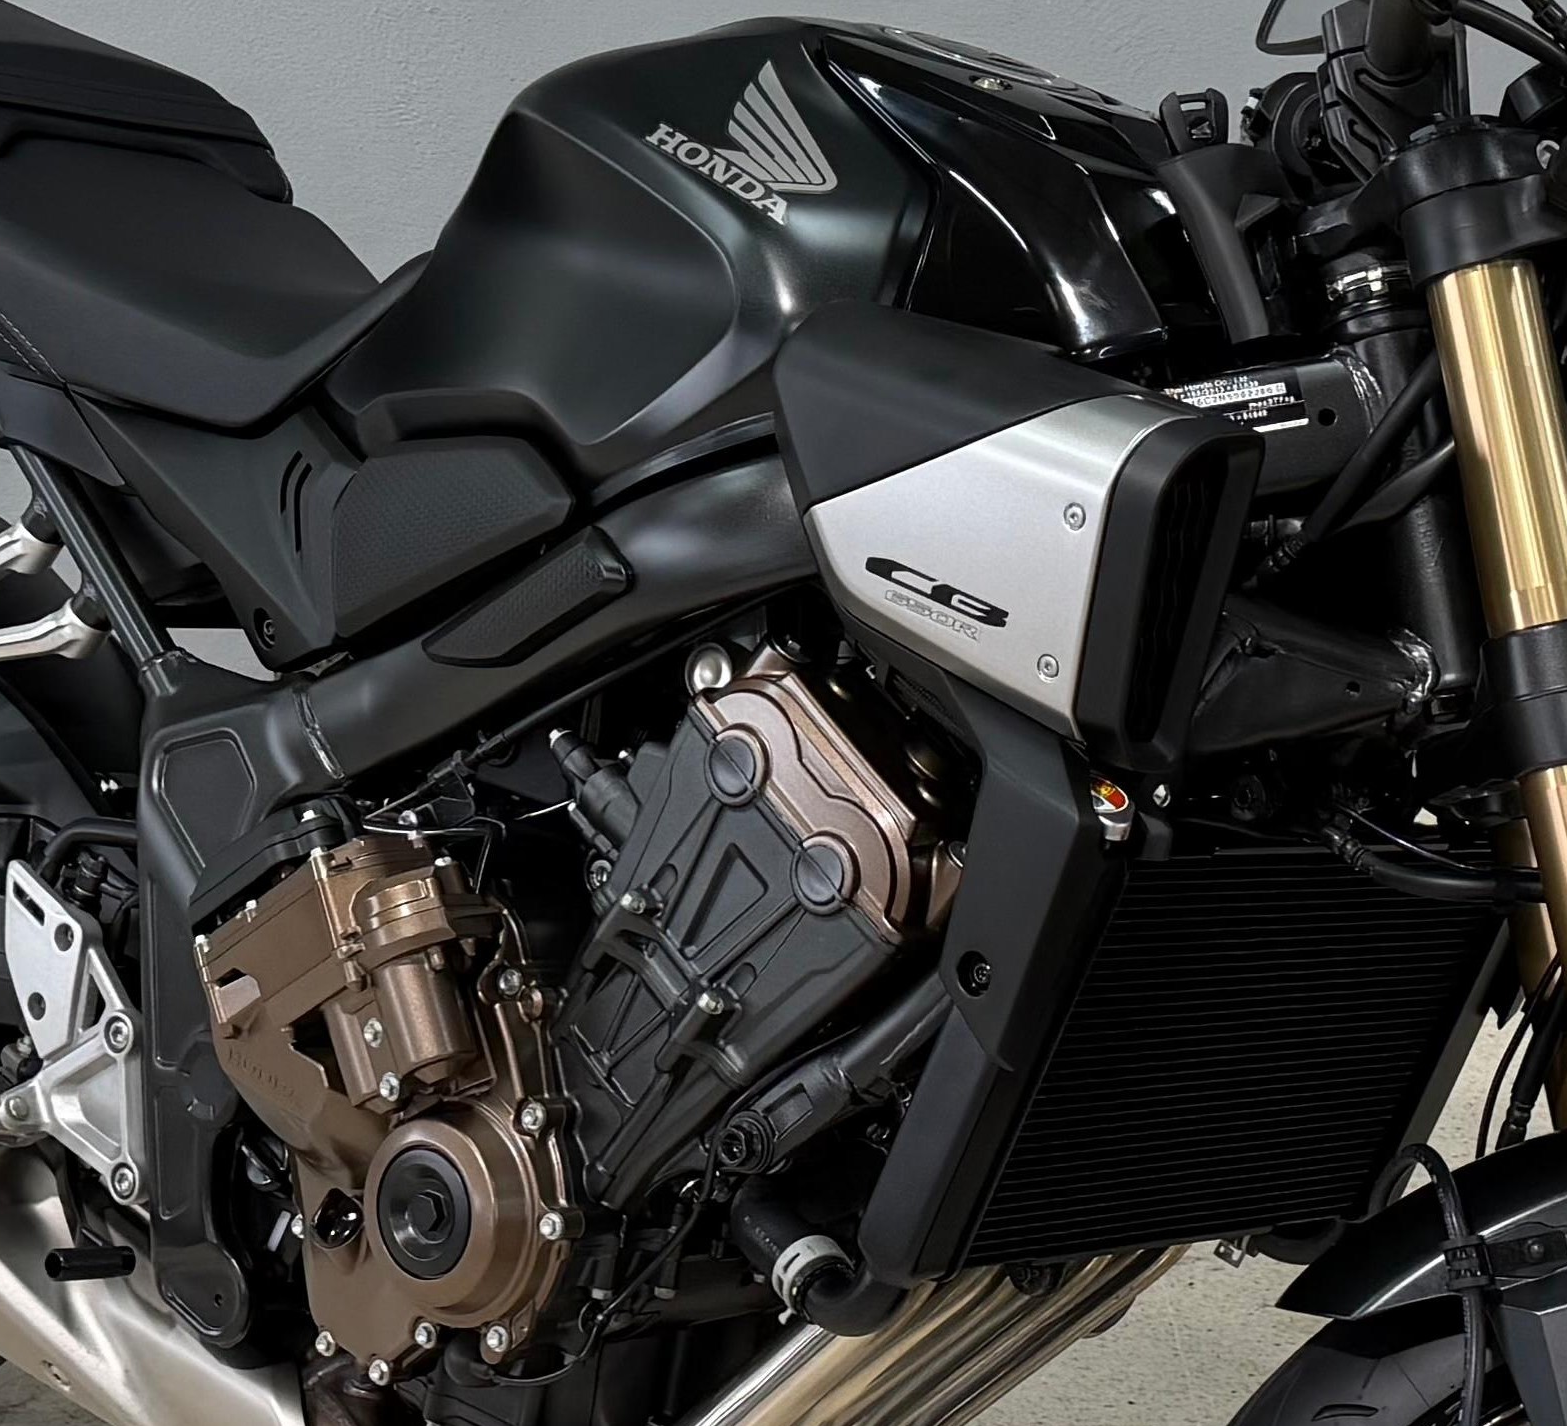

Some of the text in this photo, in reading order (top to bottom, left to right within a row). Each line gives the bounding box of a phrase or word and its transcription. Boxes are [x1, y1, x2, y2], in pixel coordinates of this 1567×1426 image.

[645, 123, 788, 226] HONDA
[865, 557, 1010, 628] CB
[885, 589, 980, 642] 650R
